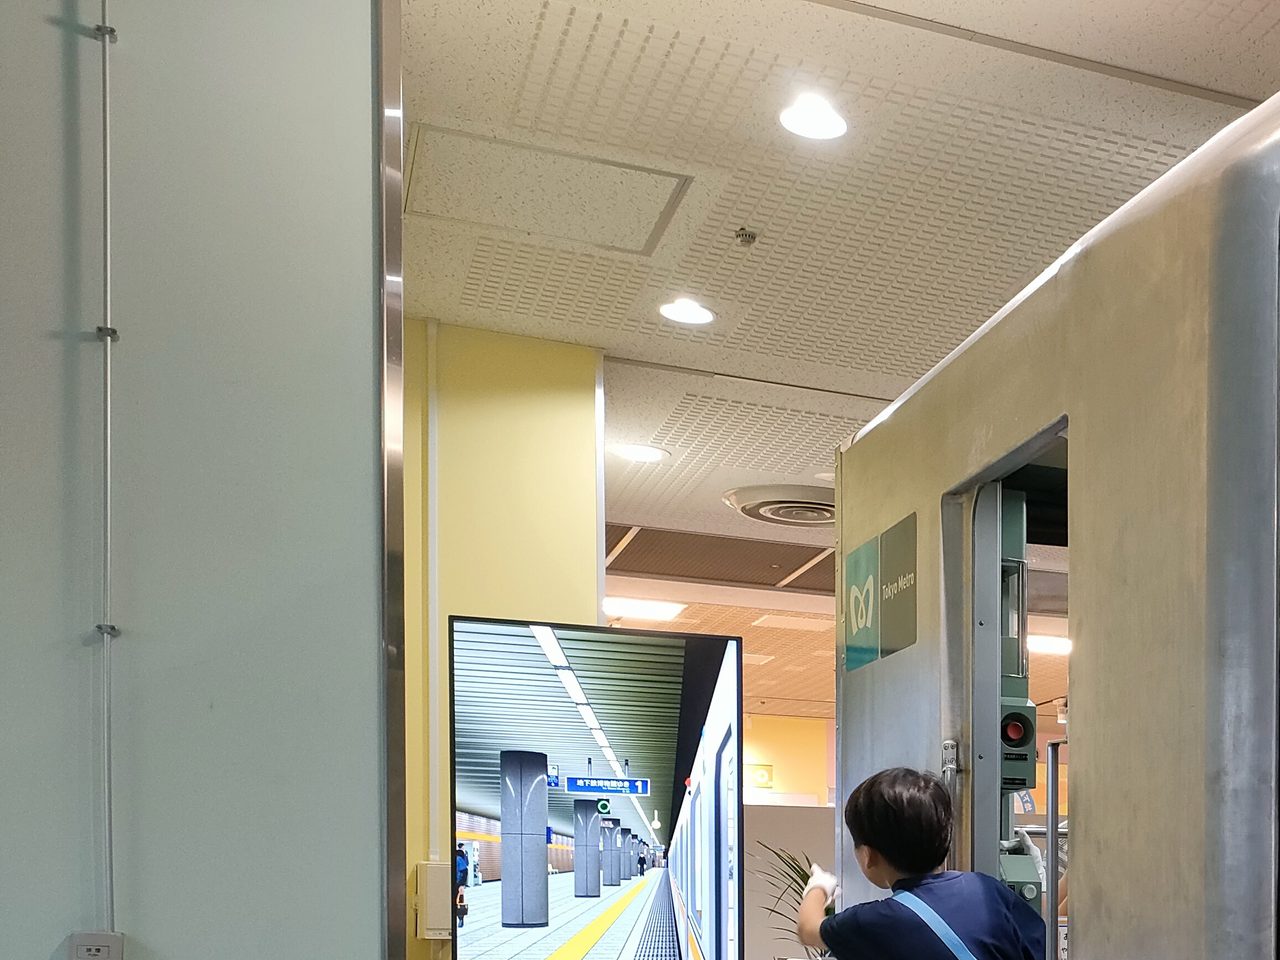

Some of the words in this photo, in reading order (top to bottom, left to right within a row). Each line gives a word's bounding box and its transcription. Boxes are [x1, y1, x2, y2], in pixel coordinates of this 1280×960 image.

[882, 582, 898, 601] Tokyo
[898, 572, 915, 592] Metro
[634, 779, 643, 794] 1
